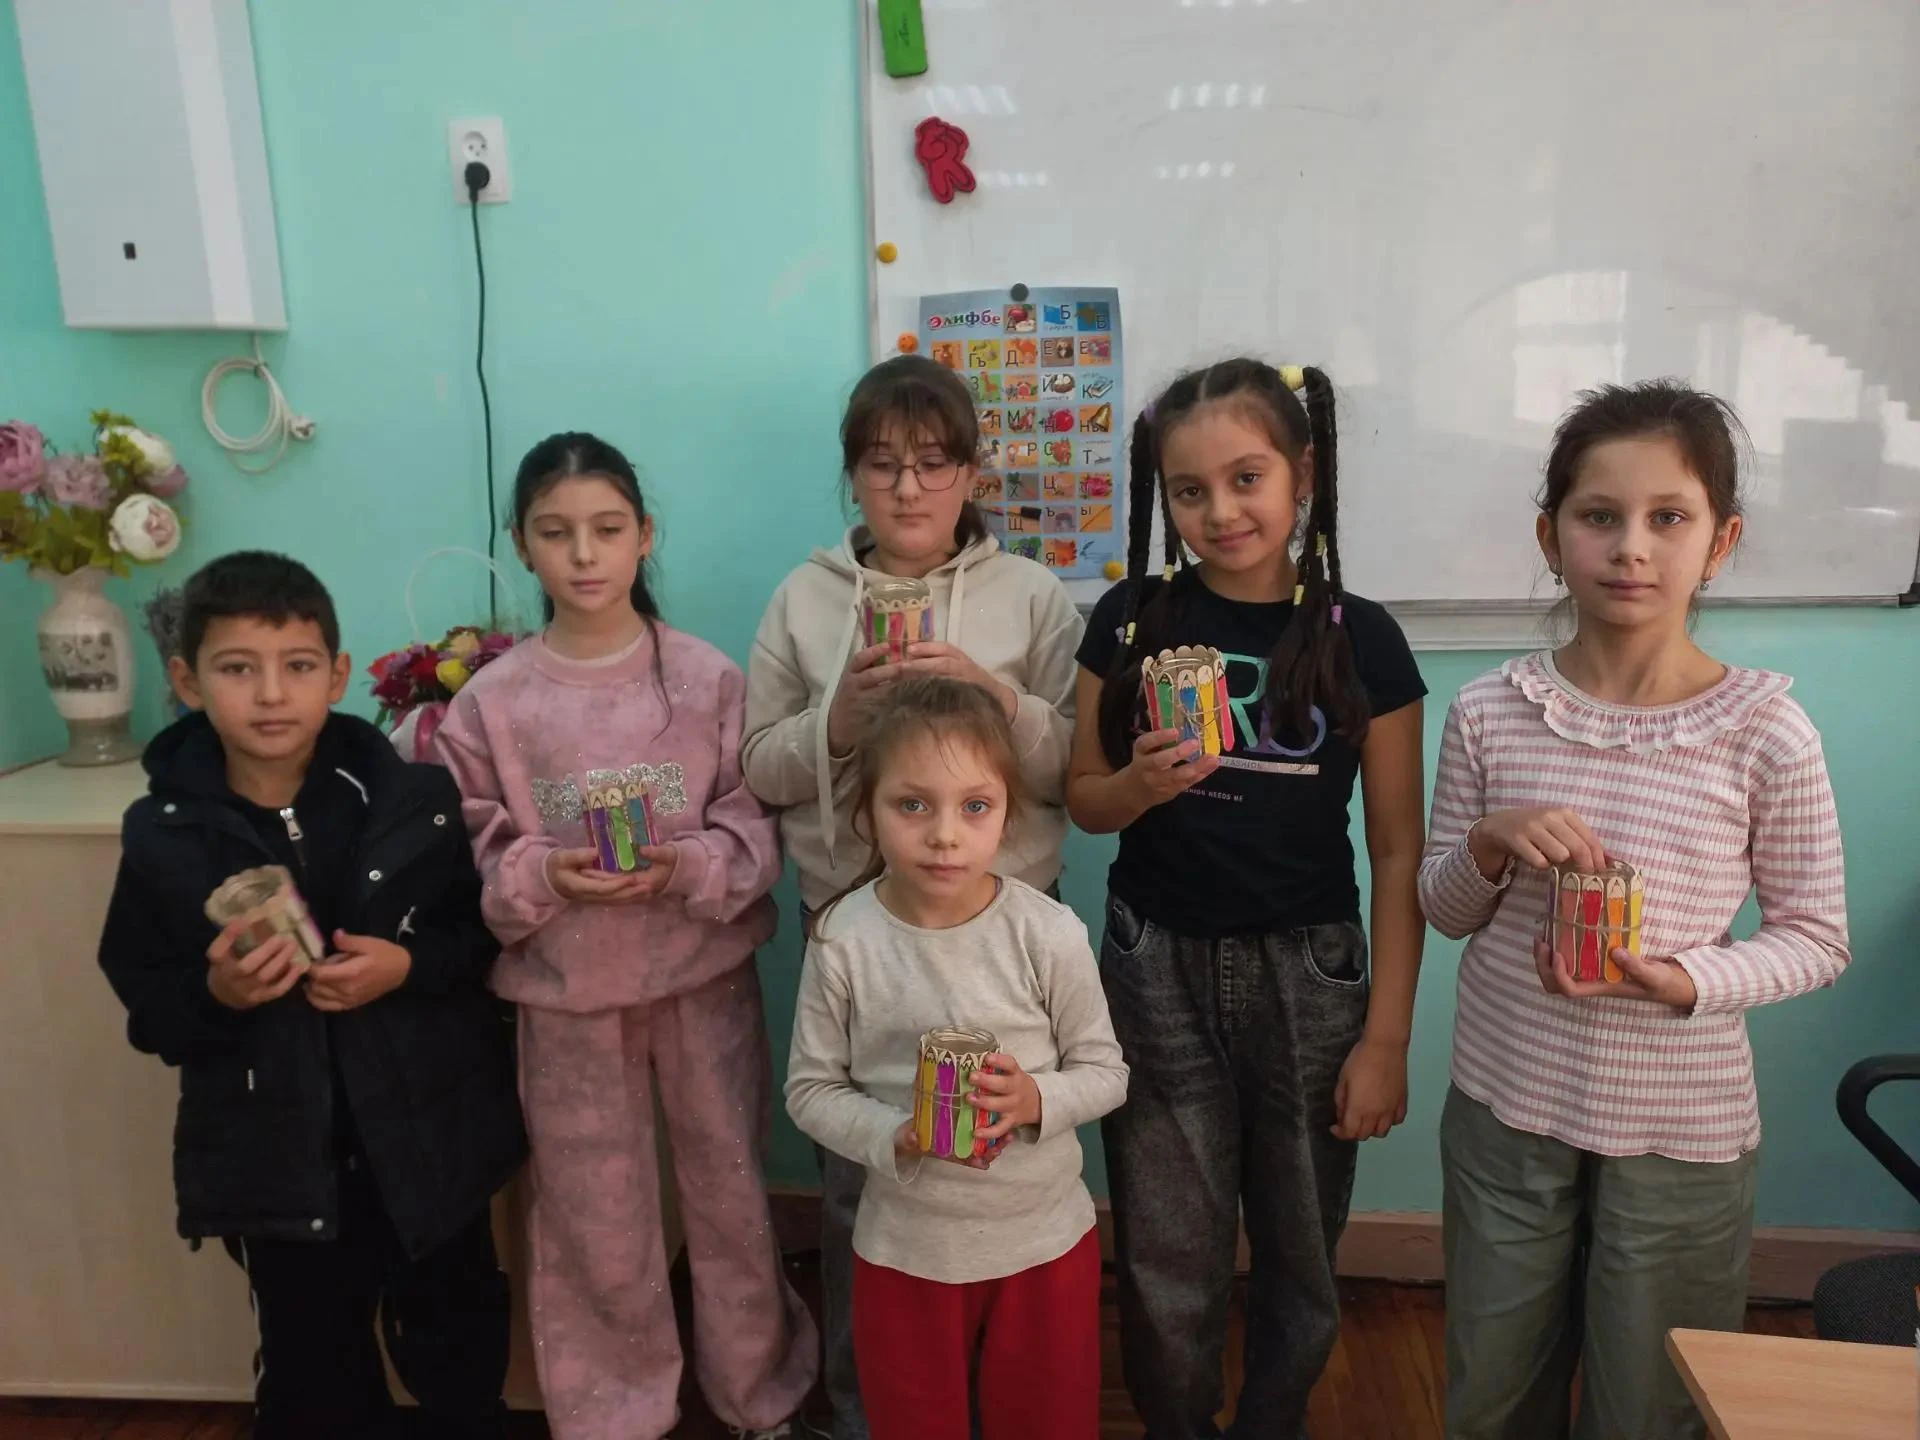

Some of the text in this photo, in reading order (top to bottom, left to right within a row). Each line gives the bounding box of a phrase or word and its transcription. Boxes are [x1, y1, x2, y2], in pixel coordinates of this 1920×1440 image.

[928, 309, 1001, 330] Элифбе
[1060, 304, 1071, 320] Б
[969, 352, 987, 368] Гъ
[1005, 350, 1019, 368] Д
[1082, 383, 1093, 399] К
[1007, 409, 1020, 424] М
[1027, 442, 1038, 457] Р
[1082, 449, 1093, 465] Т
[1045, 552, 1056, 566] Я
[1208, 791, 1232, 801] NEEDS
